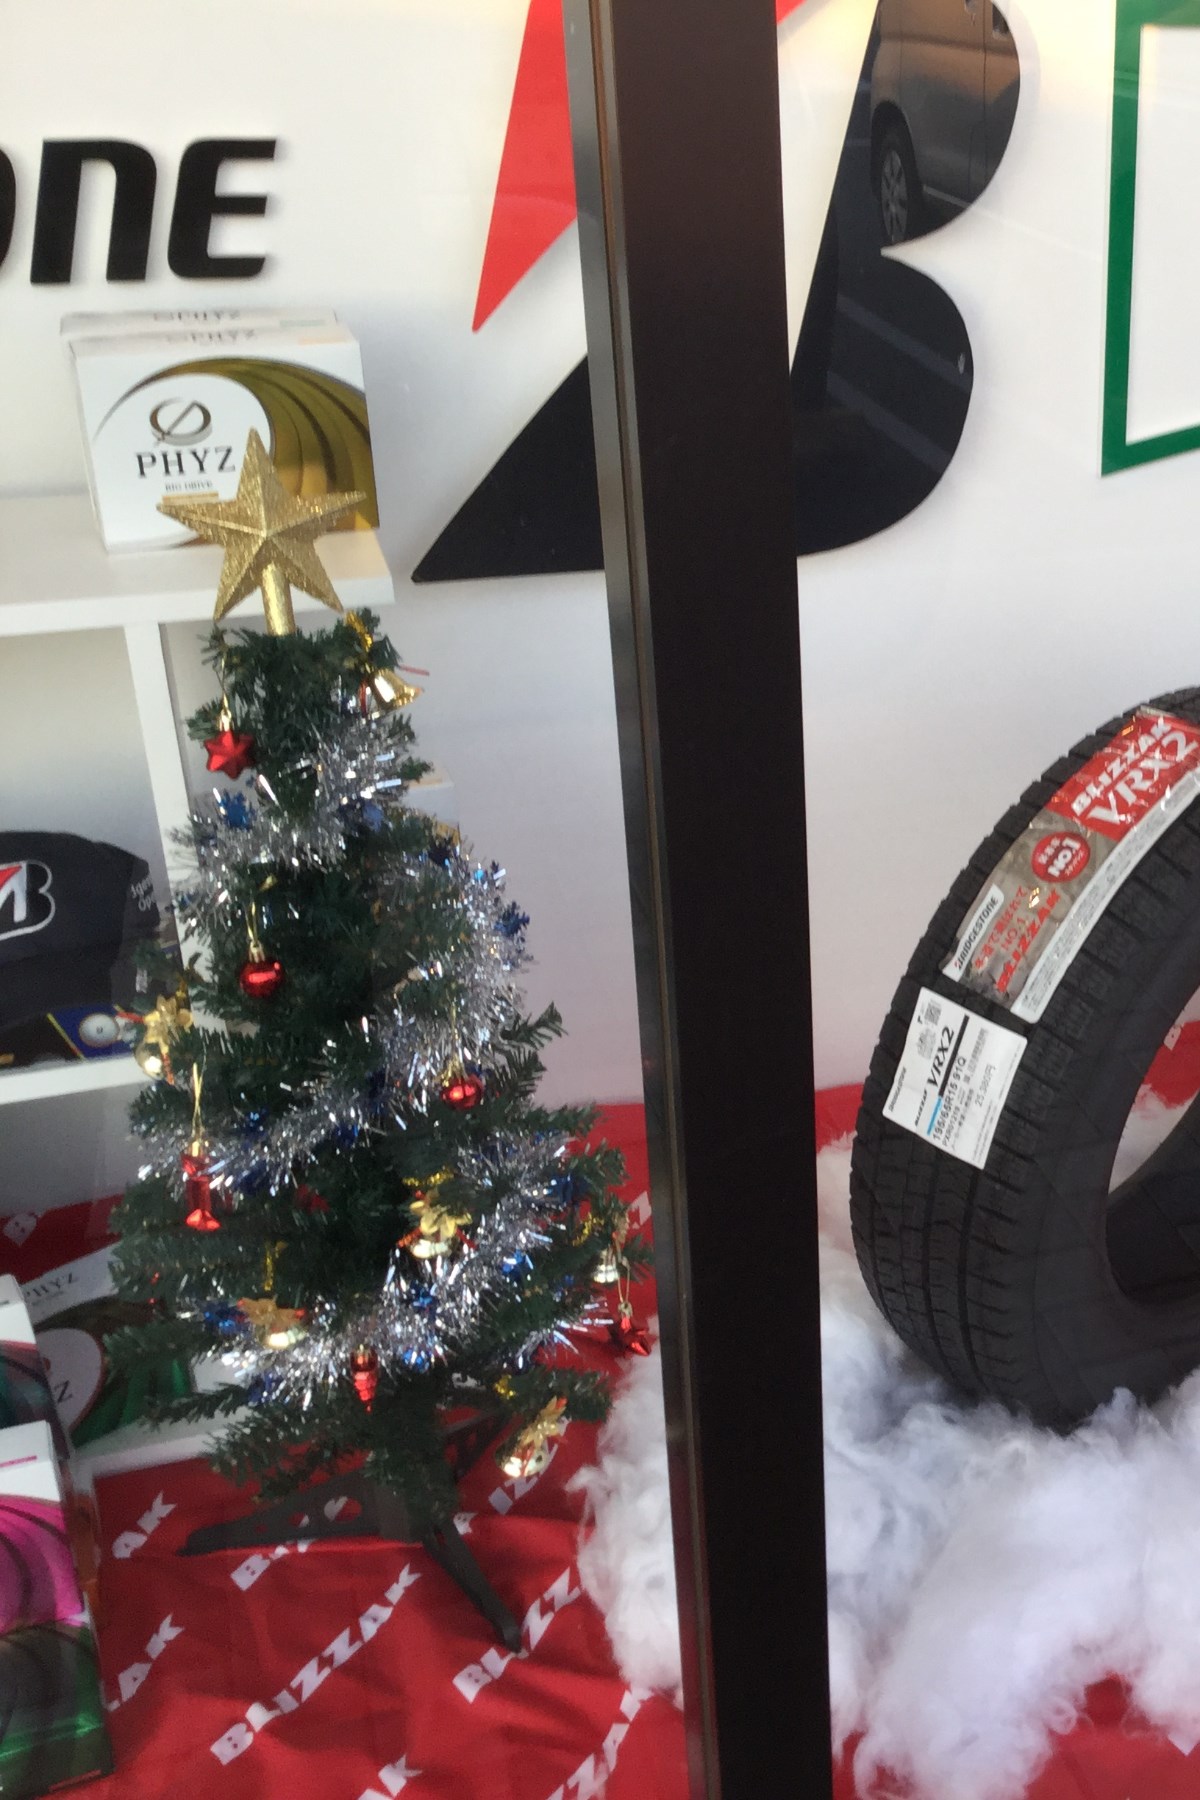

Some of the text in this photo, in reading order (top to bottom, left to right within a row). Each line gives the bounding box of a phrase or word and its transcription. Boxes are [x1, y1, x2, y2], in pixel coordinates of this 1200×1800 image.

[0, 136, 277, 286] NE
[136, 446, 236, 478] PHYZ
[1071, 715, 1172, 817] BLIZZAK
[1087, 731, 1199, 826] VRX2
[954, 896, 998, 972] BRIDGESTONE
[995, 887, 1062, 992] BLIZZAK
[927, 1026, 955, 1088] VRX2
